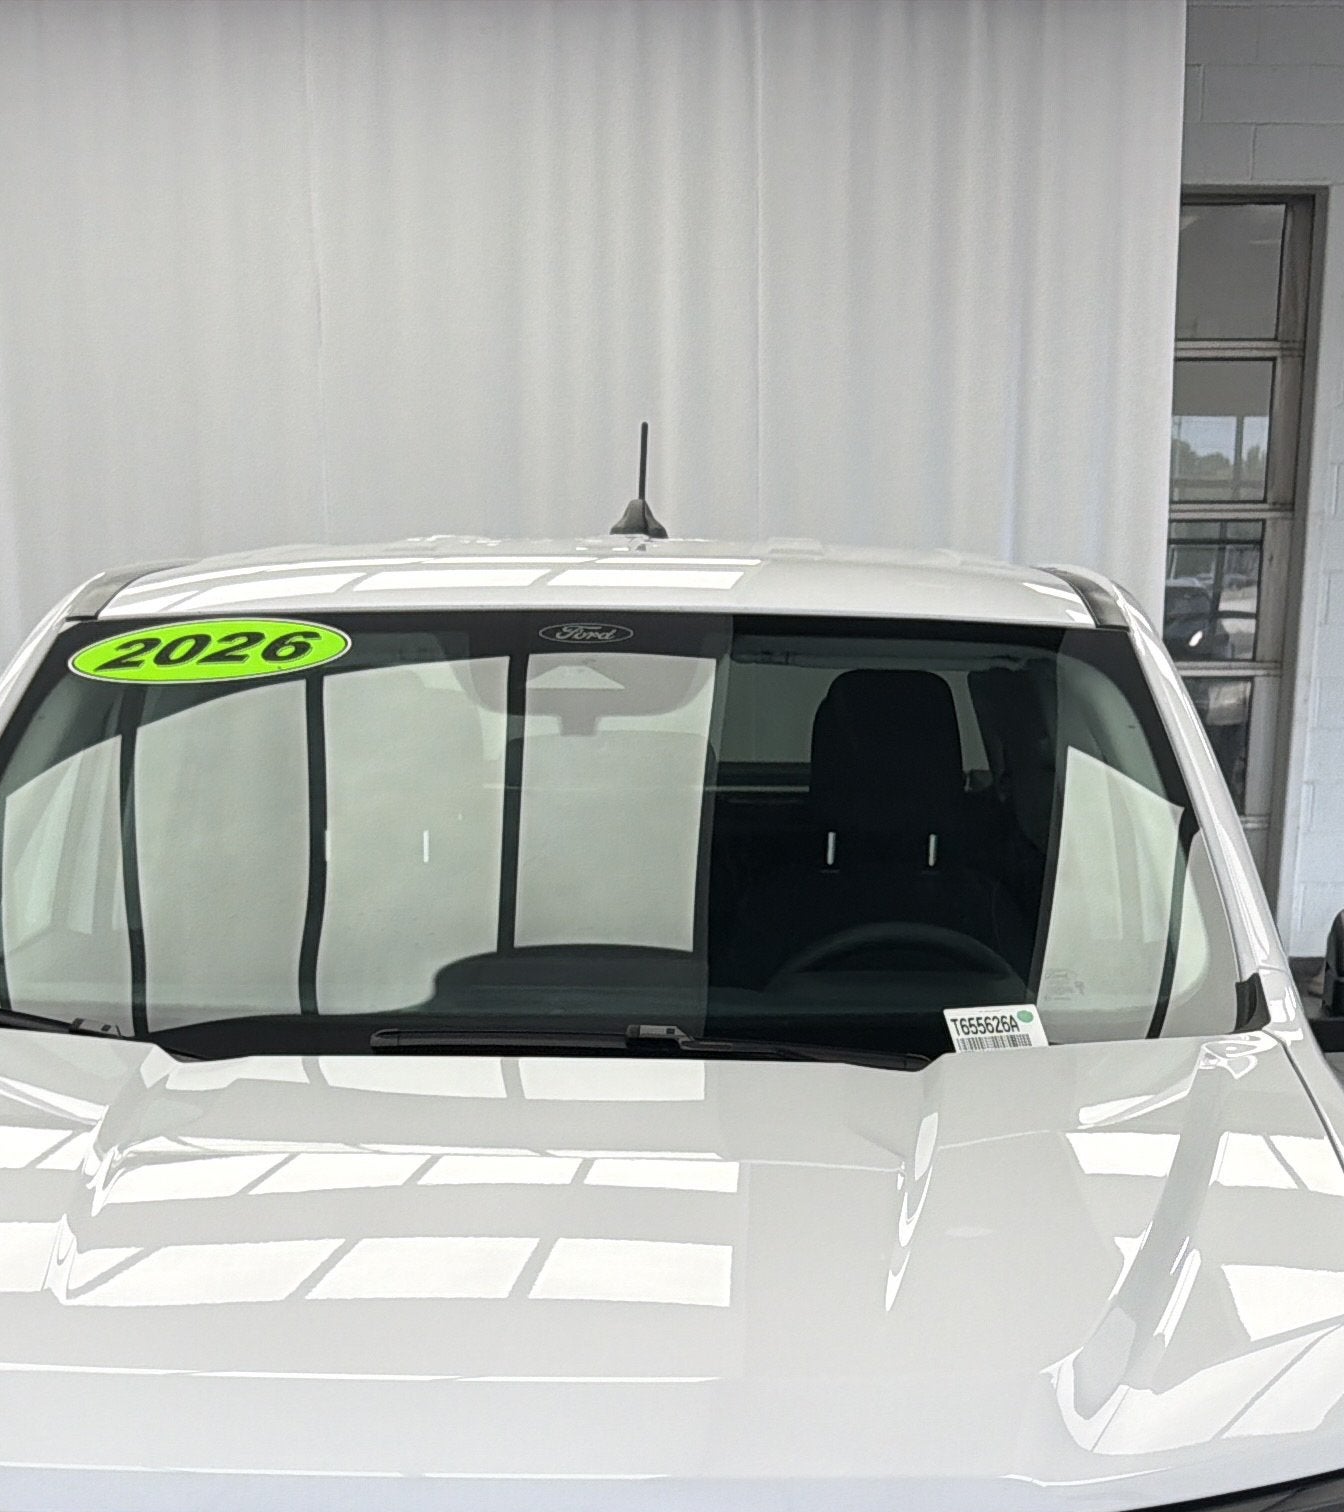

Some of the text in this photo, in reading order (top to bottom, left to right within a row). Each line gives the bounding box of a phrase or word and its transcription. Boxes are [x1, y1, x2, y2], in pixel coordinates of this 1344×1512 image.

[556, 625, 617, 640] Ford
[93, 631, 323, 672] 2026
[950, 1014, 1020, 1036] T655626A
